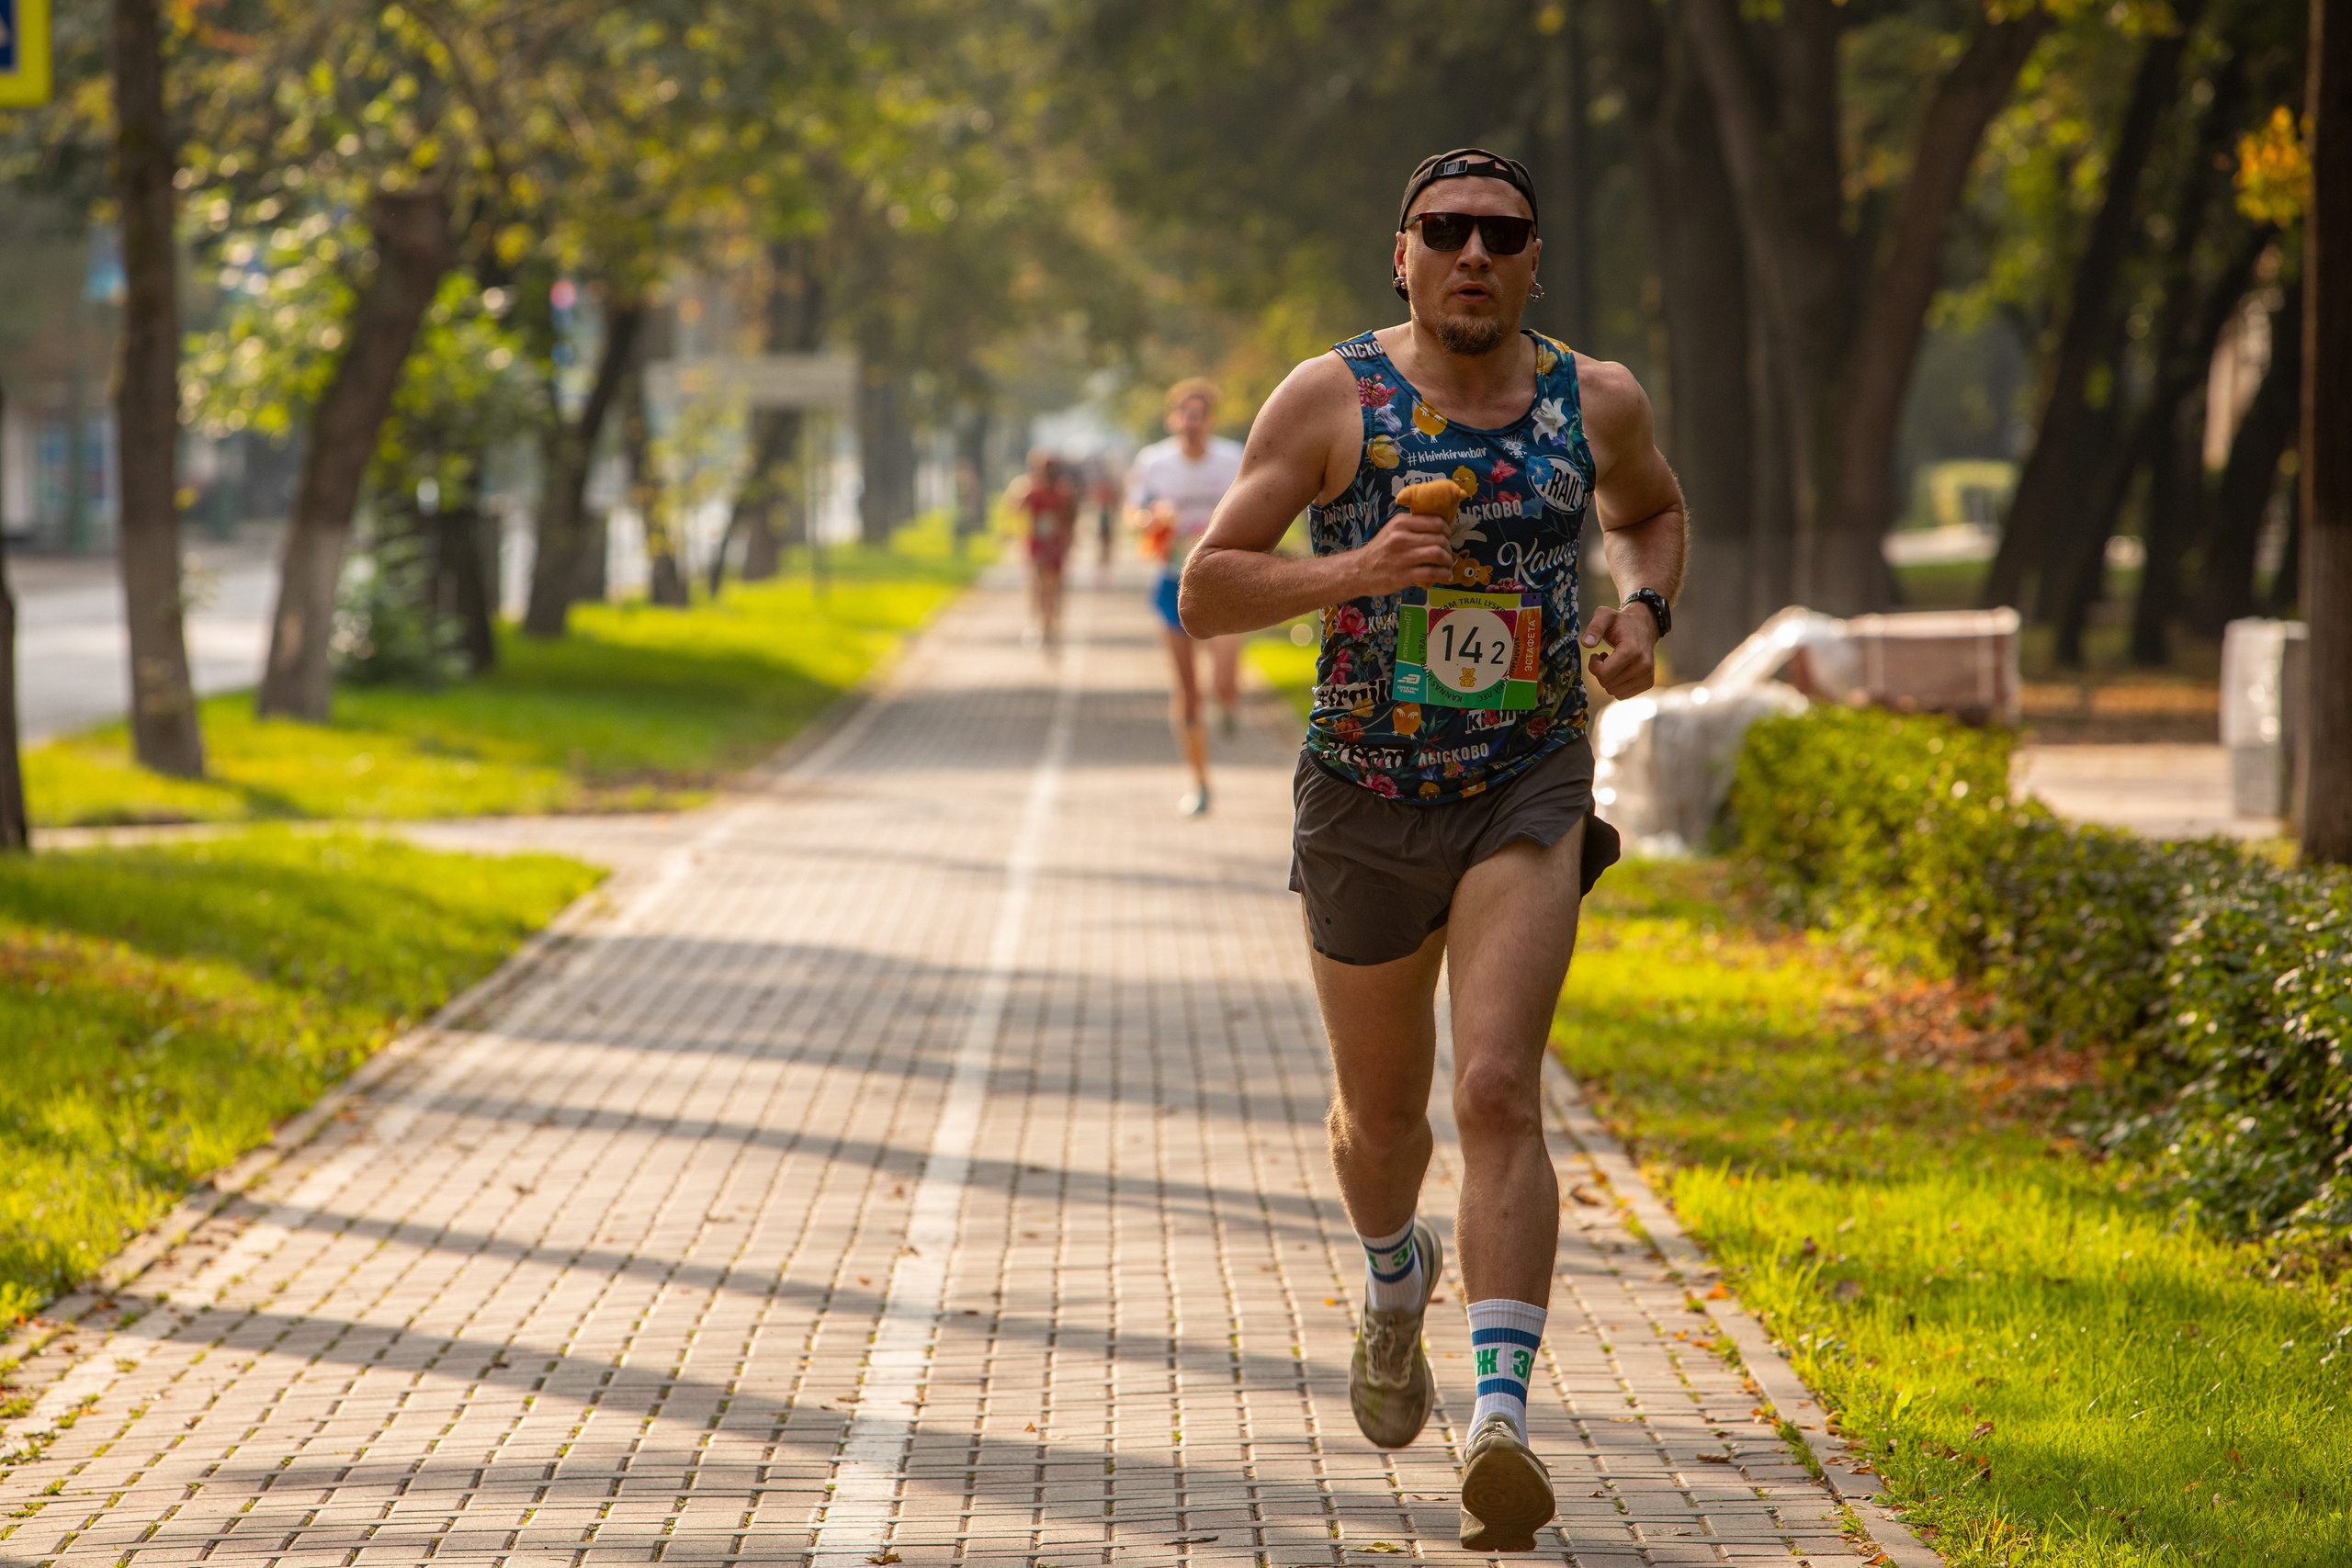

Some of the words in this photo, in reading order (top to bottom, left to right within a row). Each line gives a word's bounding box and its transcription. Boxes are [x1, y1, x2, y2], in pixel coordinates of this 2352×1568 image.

[1408, 446, 1487, 467] #khimkirunbar
[1541, 465, 1579, 510] RAIL
[1430, 601, 1457, 622] DREAM
[1484, 600, 1513, 624] LYSKOVO
[1419, 632, 1428, 654] TRAIL
[1525, 620, 1535, 671] ЭСТАФЕТА
[1430, 681, 1463, 703] KANNAS
[1477, 692, 1493, 703] ЛЕС
[1419, 742, 1489, 766] ЛЫСКОВО
